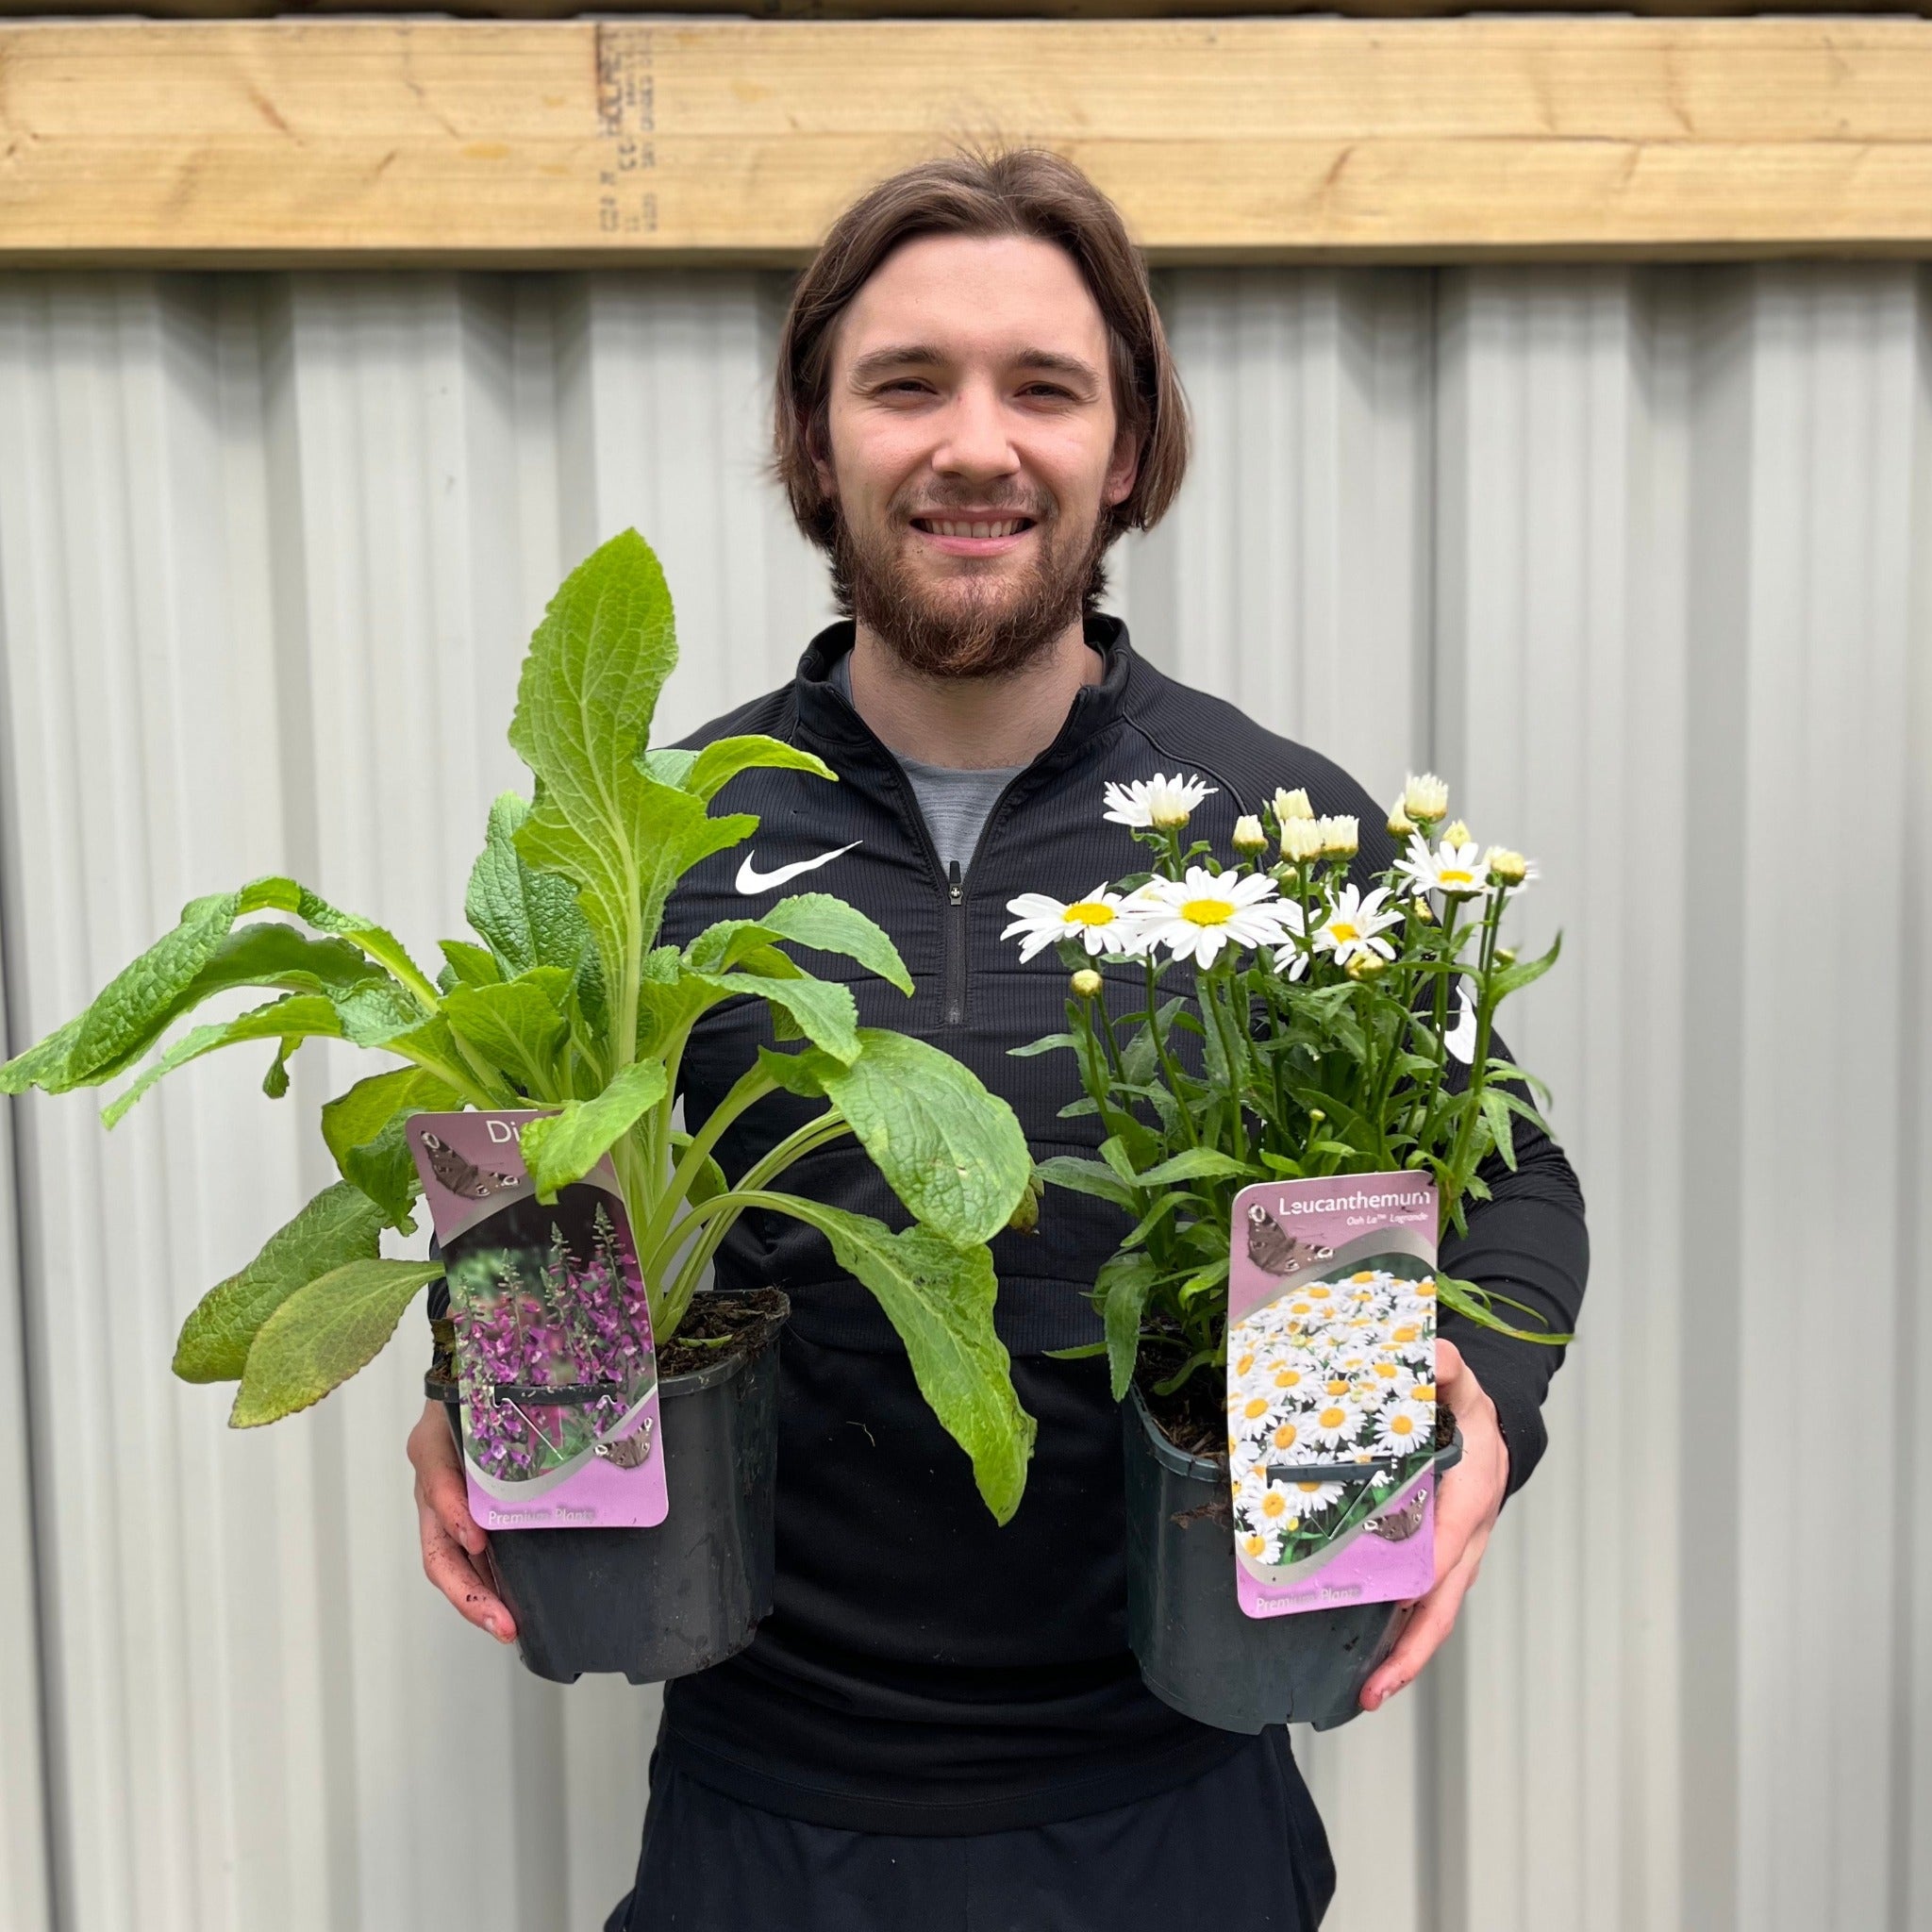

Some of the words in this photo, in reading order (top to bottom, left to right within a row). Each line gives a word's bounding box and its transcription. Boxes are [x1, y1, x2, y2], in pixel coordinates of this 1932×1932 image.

[486, 1119, 520, 1144] Di
[1279, 1191, 1431, 1216] Leucanthemum
[490, 1509, 550, 1525] Premium
[1257, 1593, 1316, 1612] Premium
